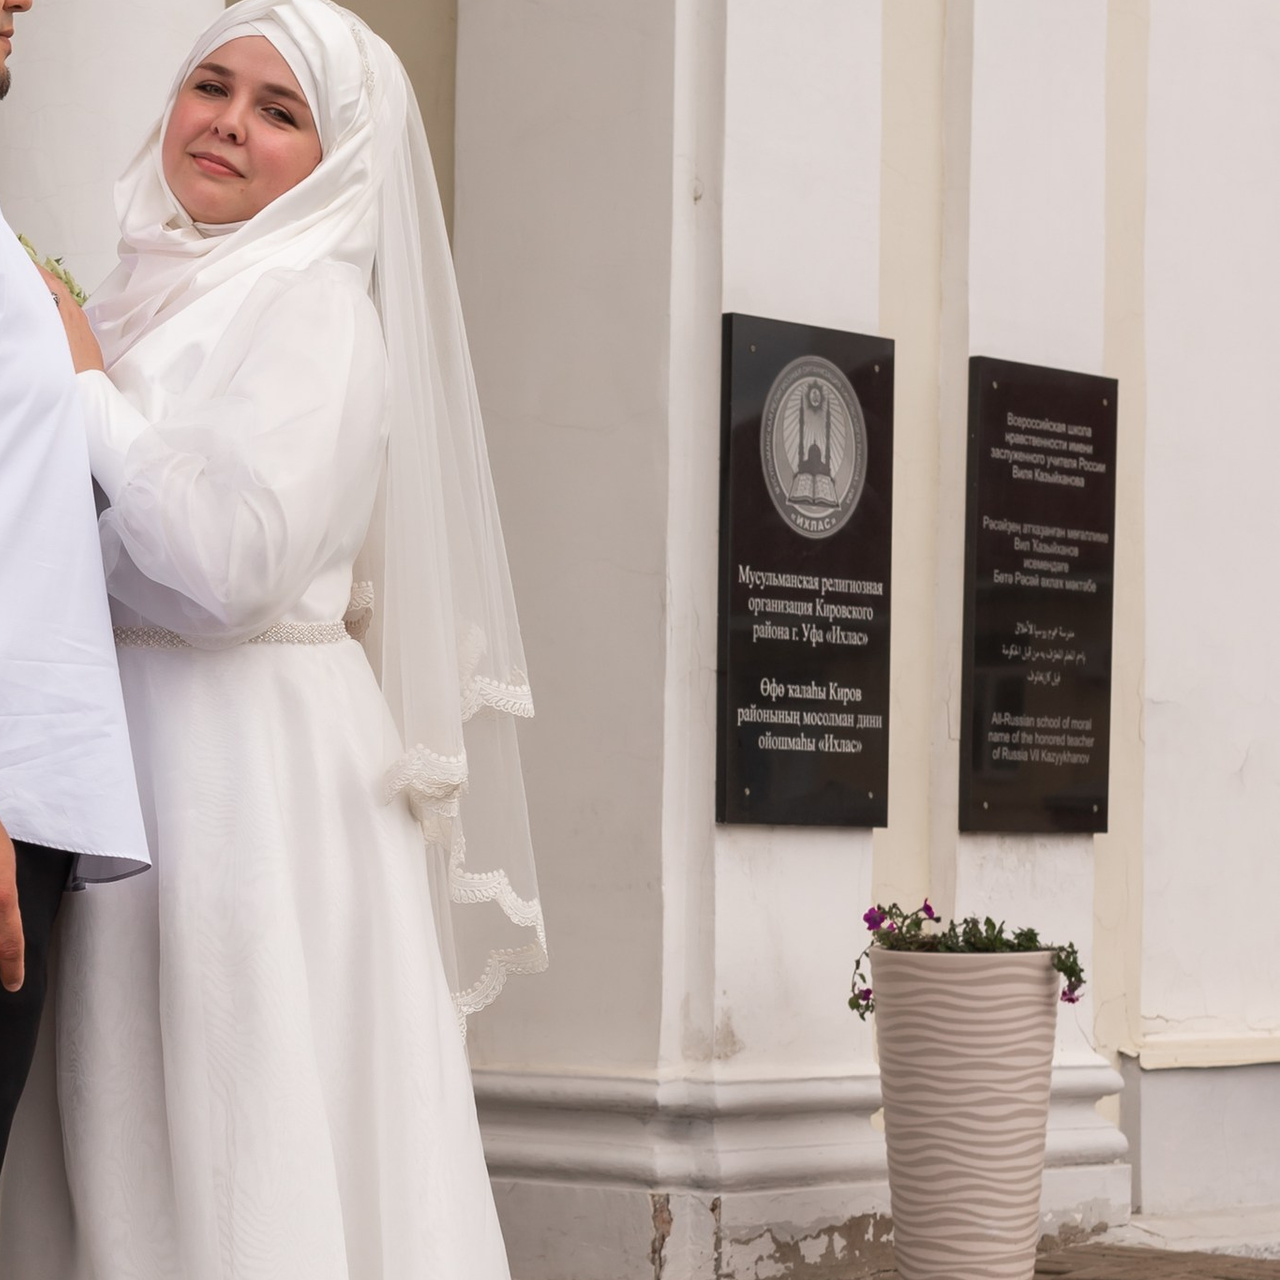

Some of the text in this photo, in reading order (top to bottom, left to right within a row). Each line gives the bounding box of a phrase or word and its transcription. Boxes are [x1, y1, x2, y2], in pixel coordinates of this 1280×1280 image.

[1007, 412, 1092, 438] Всероссийская школа
[1005, 432, 1093, 454] нравственности имени
[991, 447, 1106, 473] заслуженного учителя России
[738, 564, 884, 596] Мусульманская религиозная
[748, 597, 874, 623] организация Кировского
[752, 621, 869, 647] района г. Уфа «Ихлас»
[760, 677, 785, 702] Өфө
[829, 682, 862, 706] Киров
[803, 710, 854, 728] мосолман
[856, 714, 883, 729] дини
[991, 712, 1092, 731] All-Russian school of moral
[818, 733, 862, 753] «Ихлас»
[988, 730, 1095, 748] name of the honored teacher
[992, 746, 1001, 760] of
[1001, 747, 1028, 761] Russia
